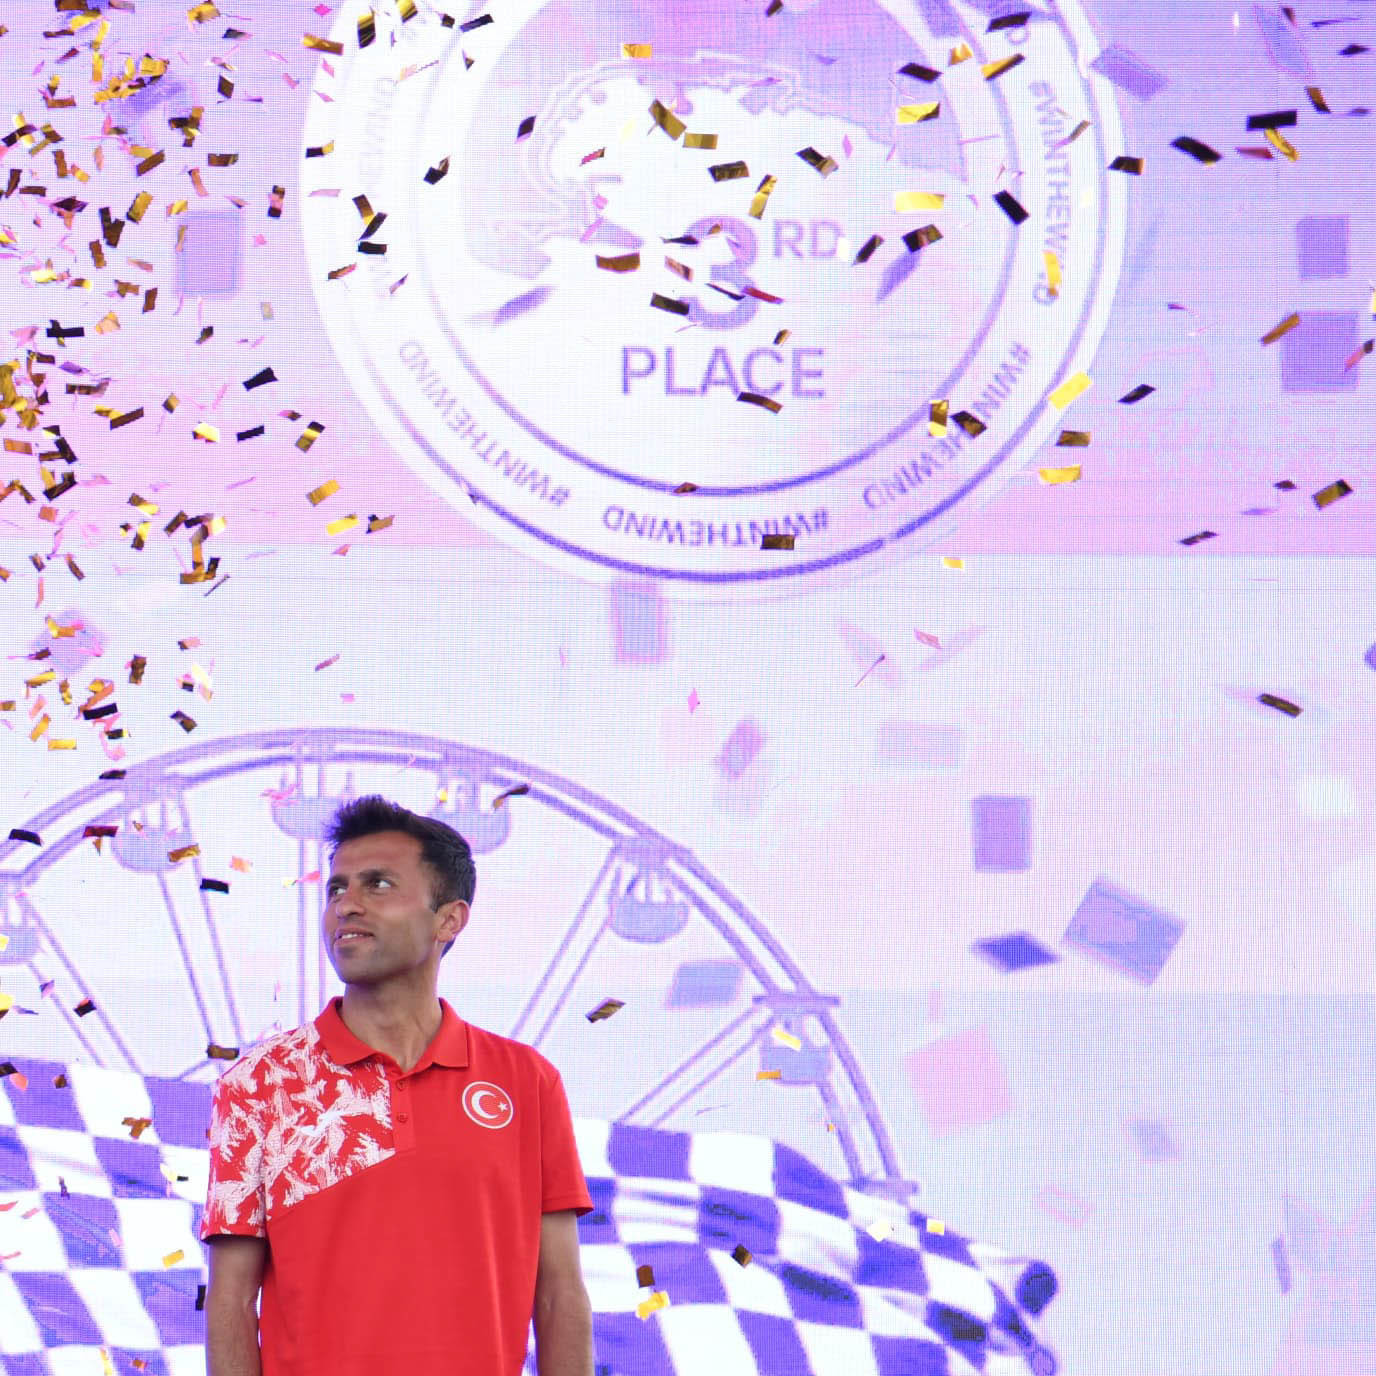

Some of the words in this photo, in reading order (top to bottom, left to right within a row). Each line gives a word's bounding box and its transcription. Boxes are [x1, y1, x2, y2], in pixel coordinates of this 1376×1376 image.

[1030, 80, 1071, 306] #WINTHEWD
[621, 346, 825, 399] PLACE
[863, 343, 1031, 511] #WINHEWIND
[602, 505, 829, 547] #WINTHEWIND
